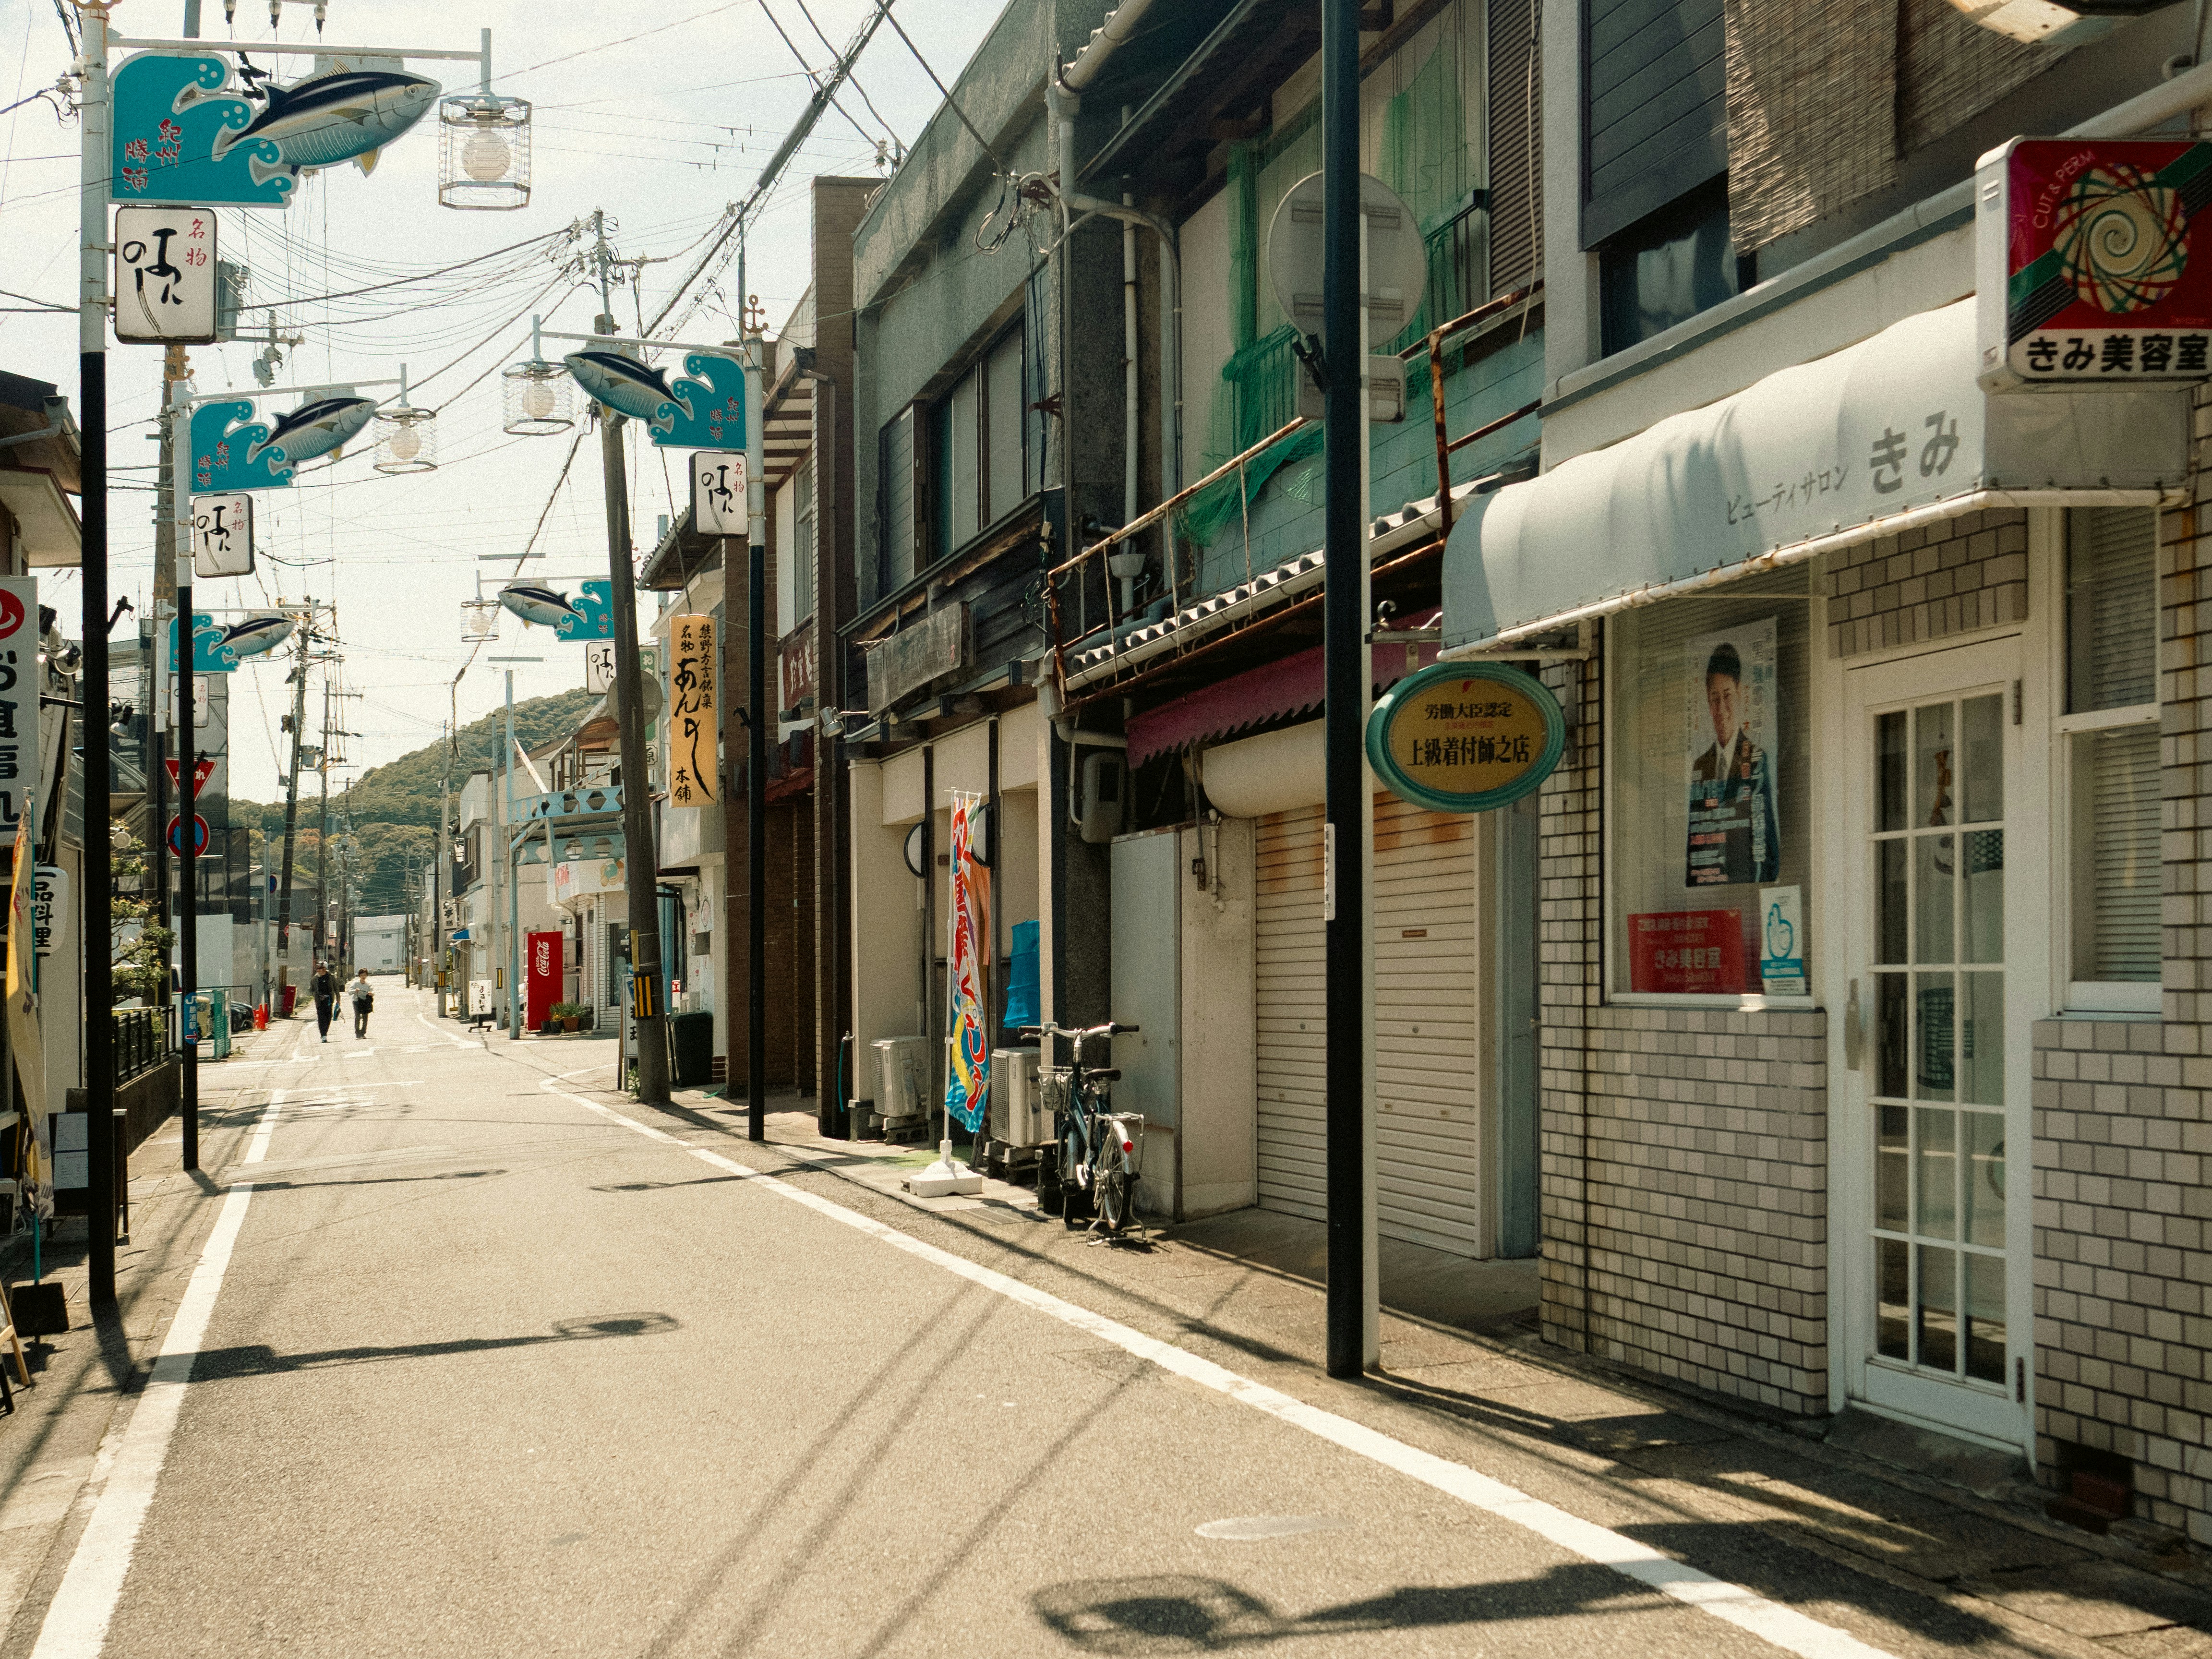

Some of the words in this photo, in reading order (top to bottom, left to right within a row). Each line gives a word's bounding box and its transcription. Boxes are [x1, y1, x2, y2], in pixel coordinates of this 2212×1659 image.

[156, 119, 182, 168] 紀州
[2032, 195, 2056, 229] CUT
[2048, 184, 2062, 195] &
[2057, 149, 2096, 181] PERM
[186, 218, 207, 266] 名物
[2026, 334, 2209, 373] きみ美容室
[1869, 410, 1960, 494] きみ
[733, 462, 744, 493] 名物
[1727, 465, 1849, 525] ビューティサロン
[232, 501, 244, 531] 名物
[681, 625, 695, 653] 名物
[1425, 702, 1513, 720] 労働大臣認定
[1407, 734, 1529, 767] 上級着付師之店
[674, 767, 691, 804] 本舗
[537, 940, 550, 976] Coca-Cola
